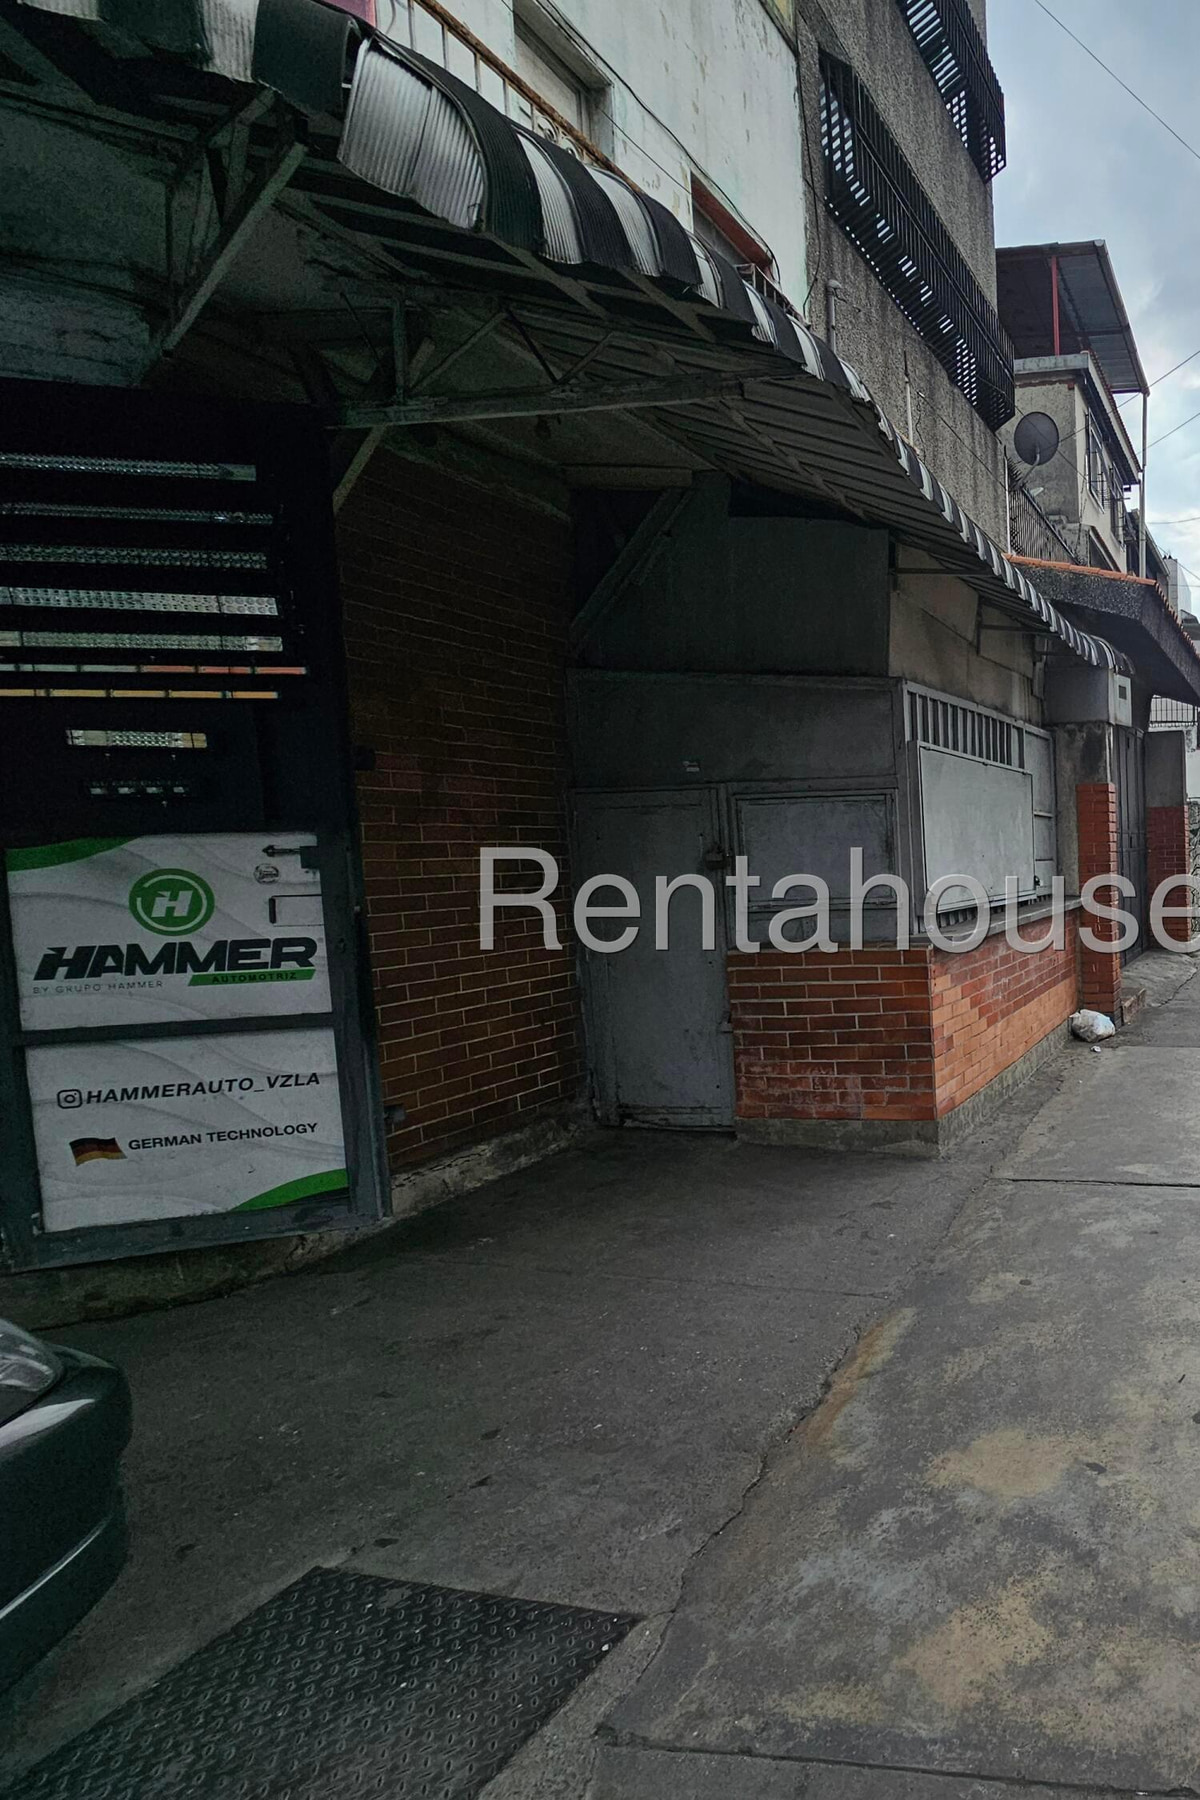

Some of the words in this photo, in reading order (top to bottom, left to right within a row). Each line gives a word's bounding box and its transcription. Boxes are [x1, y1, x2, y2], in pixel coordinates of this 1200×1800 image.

[33, 936, 318, 981] HAMMER
[33, 986, 50, 994] BY
[55, 983, 102, 993] GRUPO
[107, 980, 164, 991] HAMMER
[211, 972, 298, 985] AUTOMOTRIZ
[86, 1072, 321, 1105] HAMMERAUTO_VZLA
[128, 1133, 202, 1151] GERMAN
[206, 1122, 319, 1143] TECHNOLOGY
